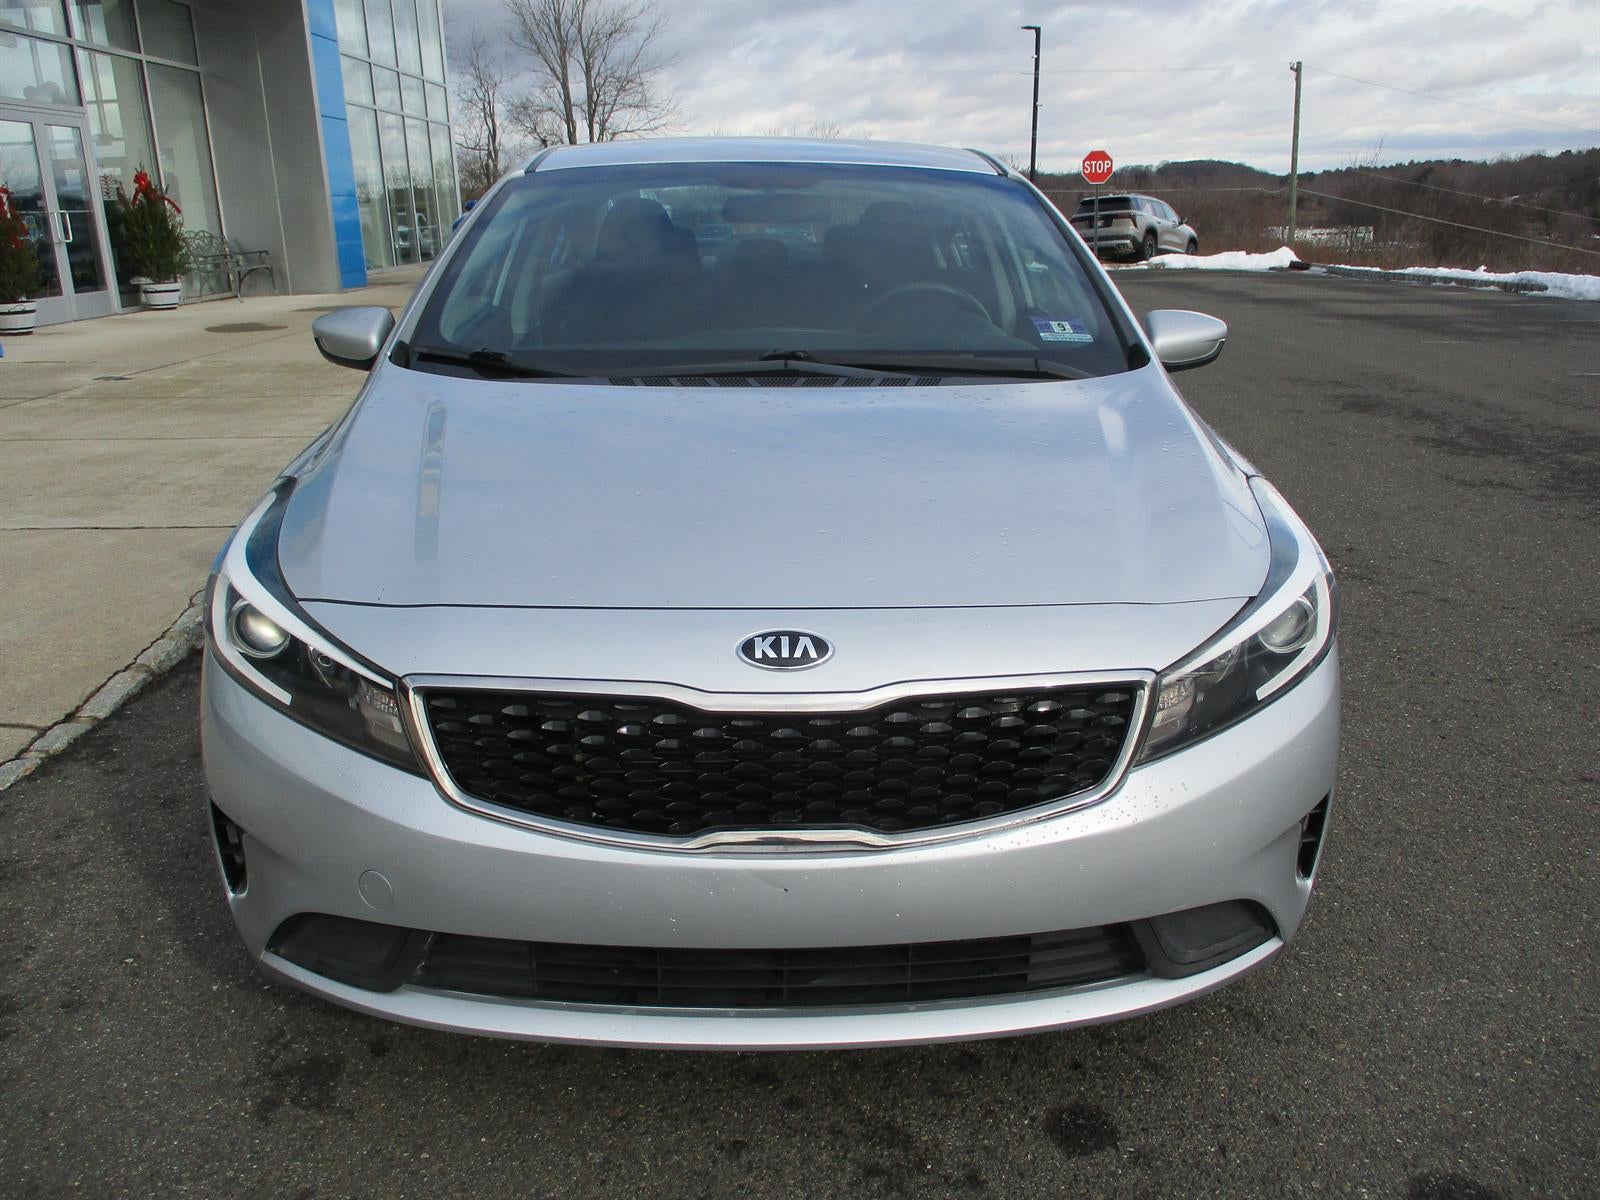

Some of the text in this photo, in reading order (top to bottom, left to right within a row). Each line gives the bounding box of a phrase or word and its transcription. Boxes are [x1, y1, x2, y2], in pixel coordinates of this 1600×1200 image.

[1084, 160, 1111, 173] STOP
[1057, 322, 1066, 331] 9
[753, 635, 818, 659] KIA
